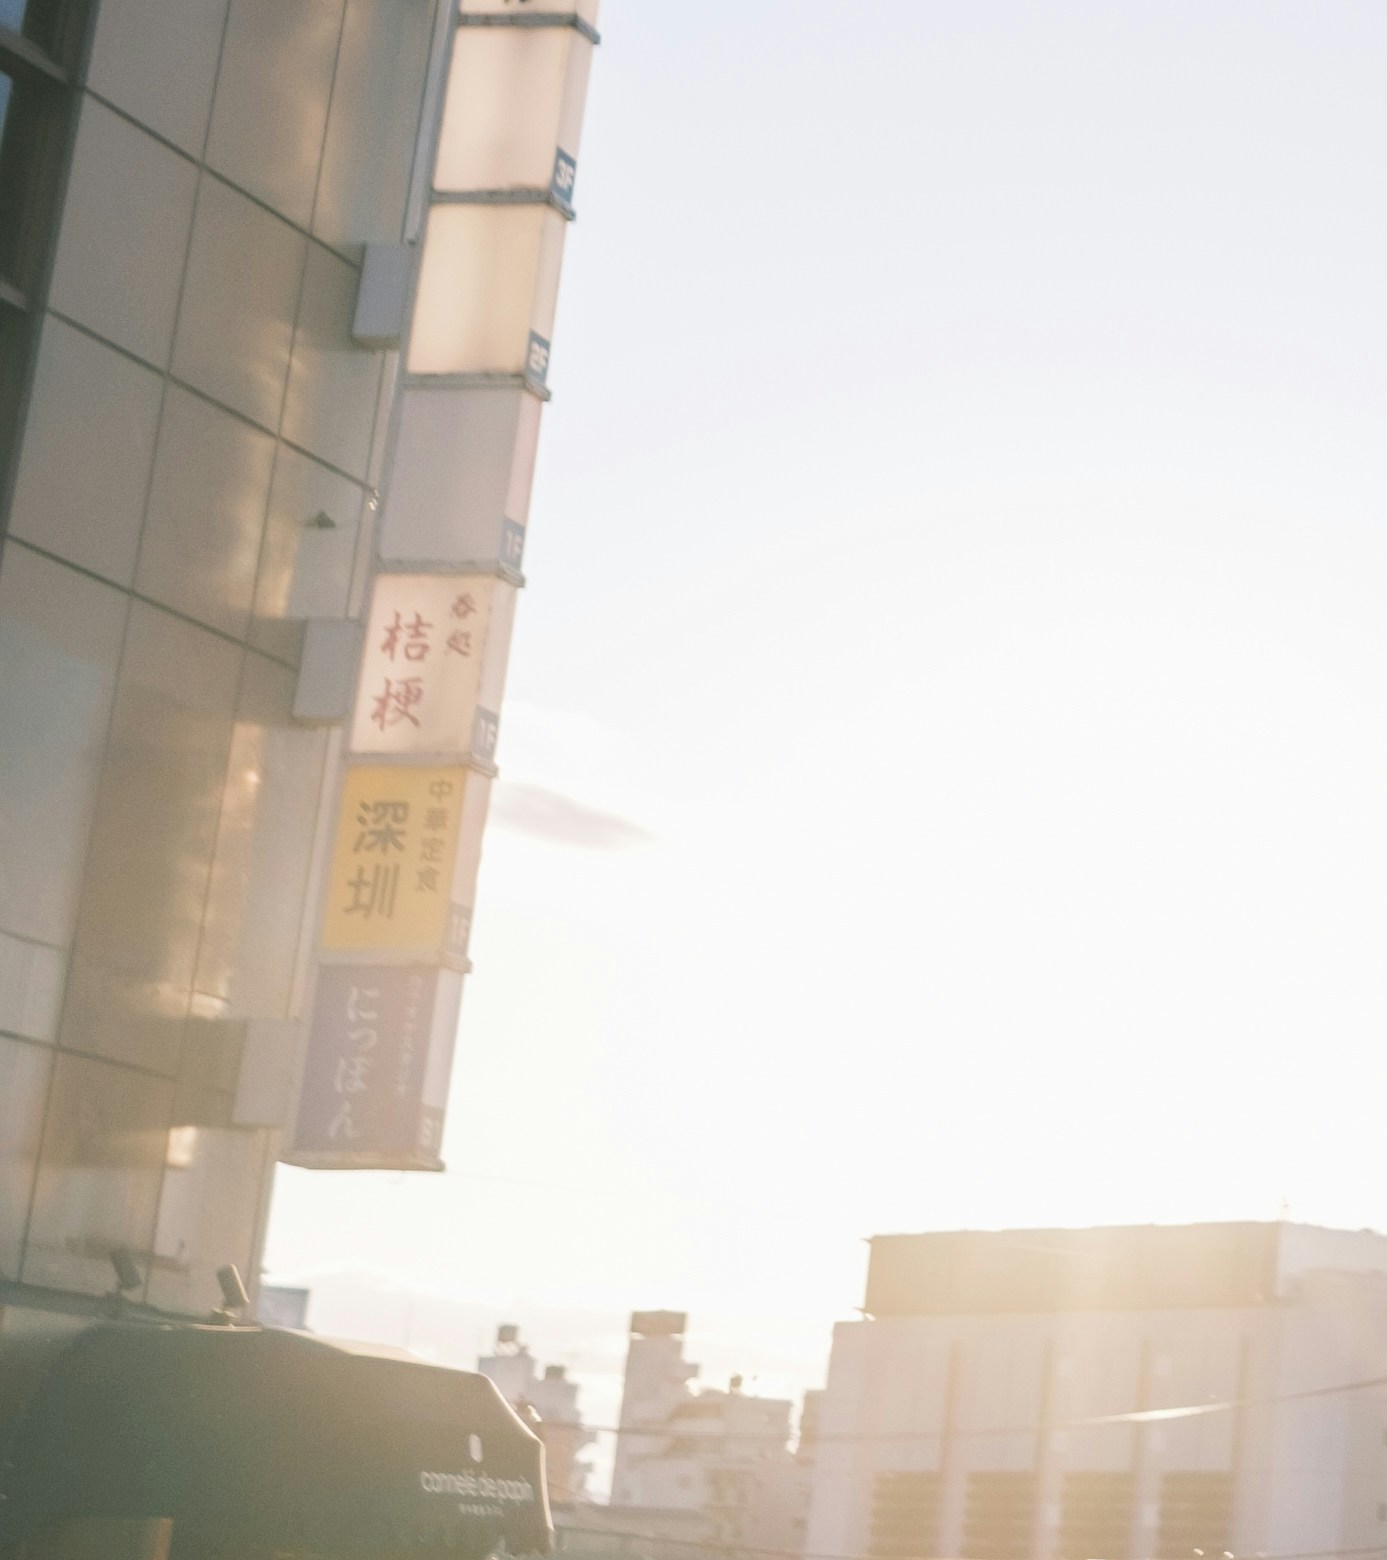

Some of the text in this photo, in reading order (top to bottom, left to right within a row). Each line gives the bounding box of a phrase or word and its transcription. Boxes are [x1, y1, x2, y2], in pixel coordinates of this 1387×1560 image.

[555, 156, 575, 191] 3F
[528, 342, 548, 372] 2F
[505, 528, 523, 558] 1F
[371, 609, 434, 732] 桔梗
[342, 799, 411, 921] 深圳
[412, 777, 454, 893] 中華定食
